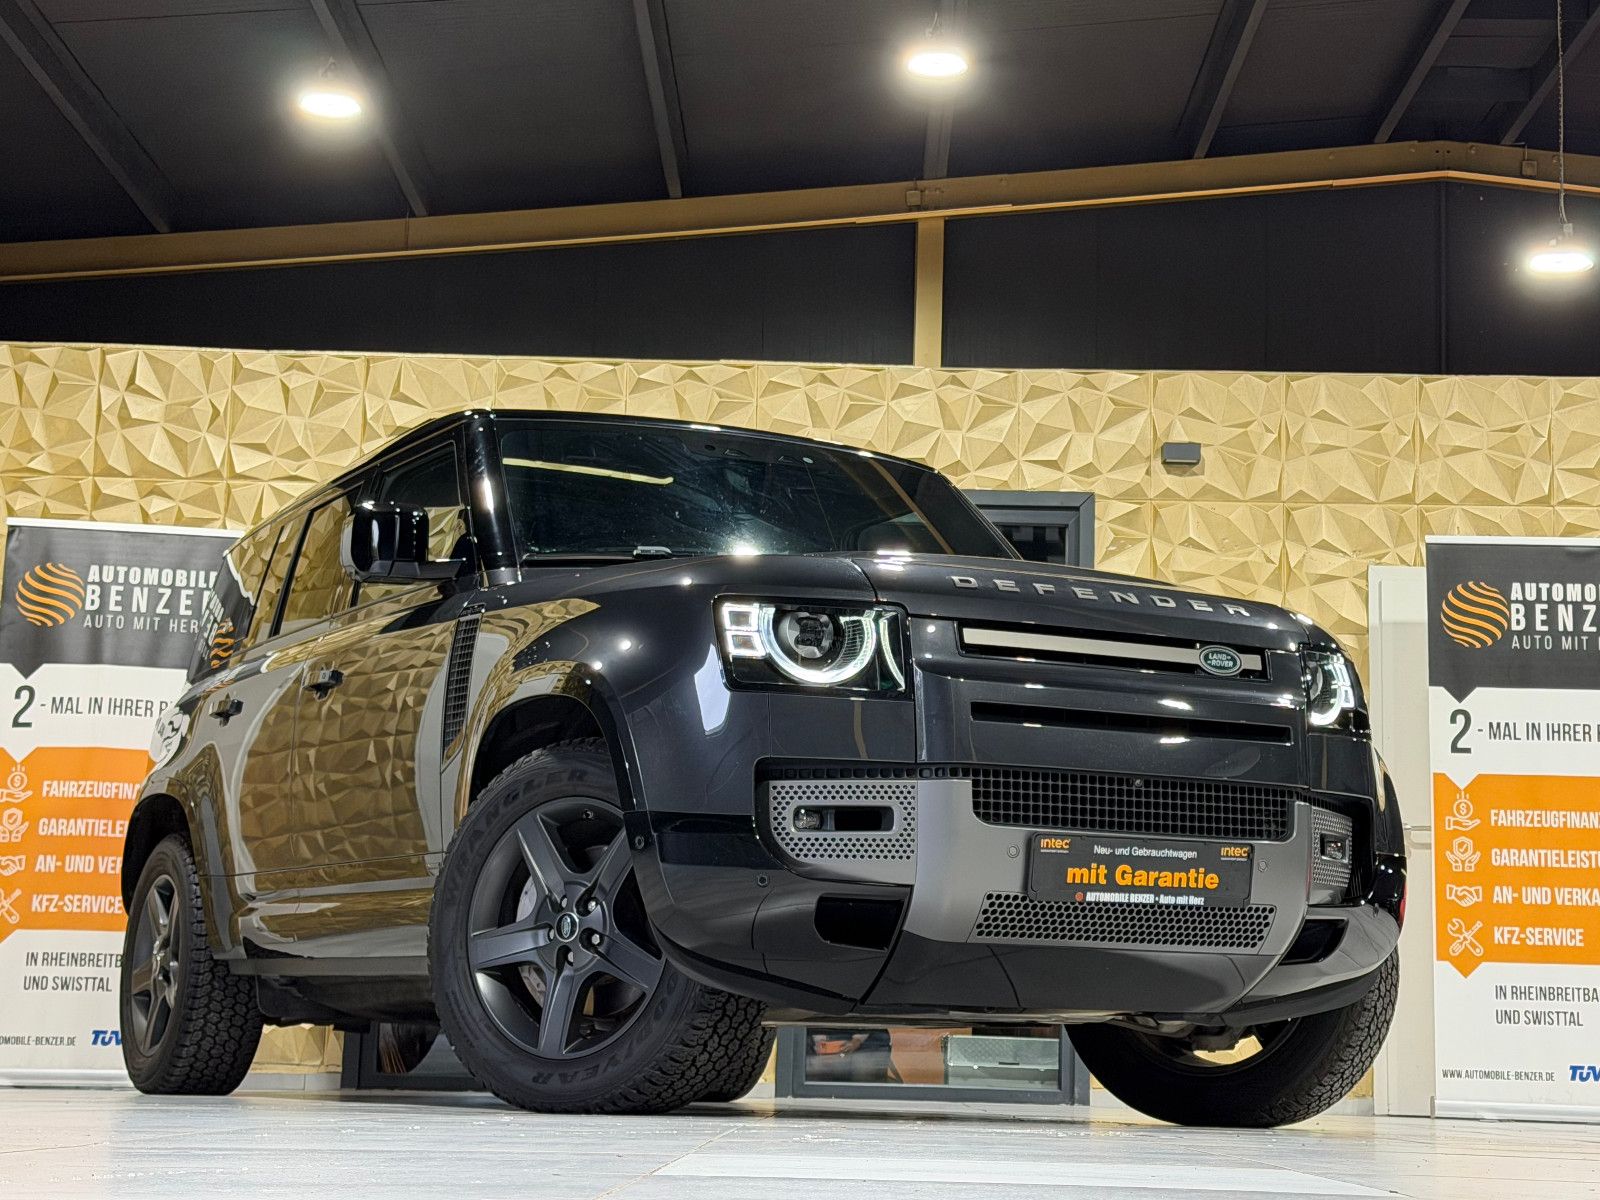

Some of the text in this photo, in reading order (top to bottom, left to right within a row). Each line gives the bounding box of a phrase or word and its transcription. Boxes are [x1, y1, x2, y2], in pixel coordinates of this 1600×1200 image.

[950, 575, 1250, 617] DEFENDER
[1510, 582, 1600, 602] AUTOMO
[83, 614, 124, 630] AUTO
[133, 616, 161, 631] MIT
[1511, 603, 1597, 633] BENZ
[1511, 635, 1553, 650] AUTO
[1561, 636, 1589, 651] MIT
[11, 685, 36, 728] 2
[50, 696, 83, 714] MAL
[87, 697, 102, 715] IN
[107, 697, 154, 717] IHRER
[1449, 709, 1472, 754] 2
[1488, 721, 1522, 741] MAL
[1526, 722, 1541, 741] IN
[1546, 723, 1592, 742] IHRER
[1490, 809, 1600, 830] FAHRZEUGFINAN
[1040, 838, 1071, 849] intec
[1220, 846, 1249, 857] intec
[1115, 846, 1130, 857] und
[1131, 846, 1198, 860] Gebrauchtwagen
[64, 856, 95, 874] UND
[1066, 863, 1220, 890] mit Garantie
[31, 894, 124, 914] KFZ-SERVICE
[1085, 891, 1129, 903] AUTOMOBILE
[1522, 886, 1551, 906] UND
[1493, 926, 1585, 947] KFZ-SERVICE
[25, 952, 38, 967] IN
[23, 976, 113, 992] UND SWISTTAL
[1495, 985, 1600, 1003] IN RHEINBREITBA
[1495, 1009, 1584, 1027] UND SWISTTAL
